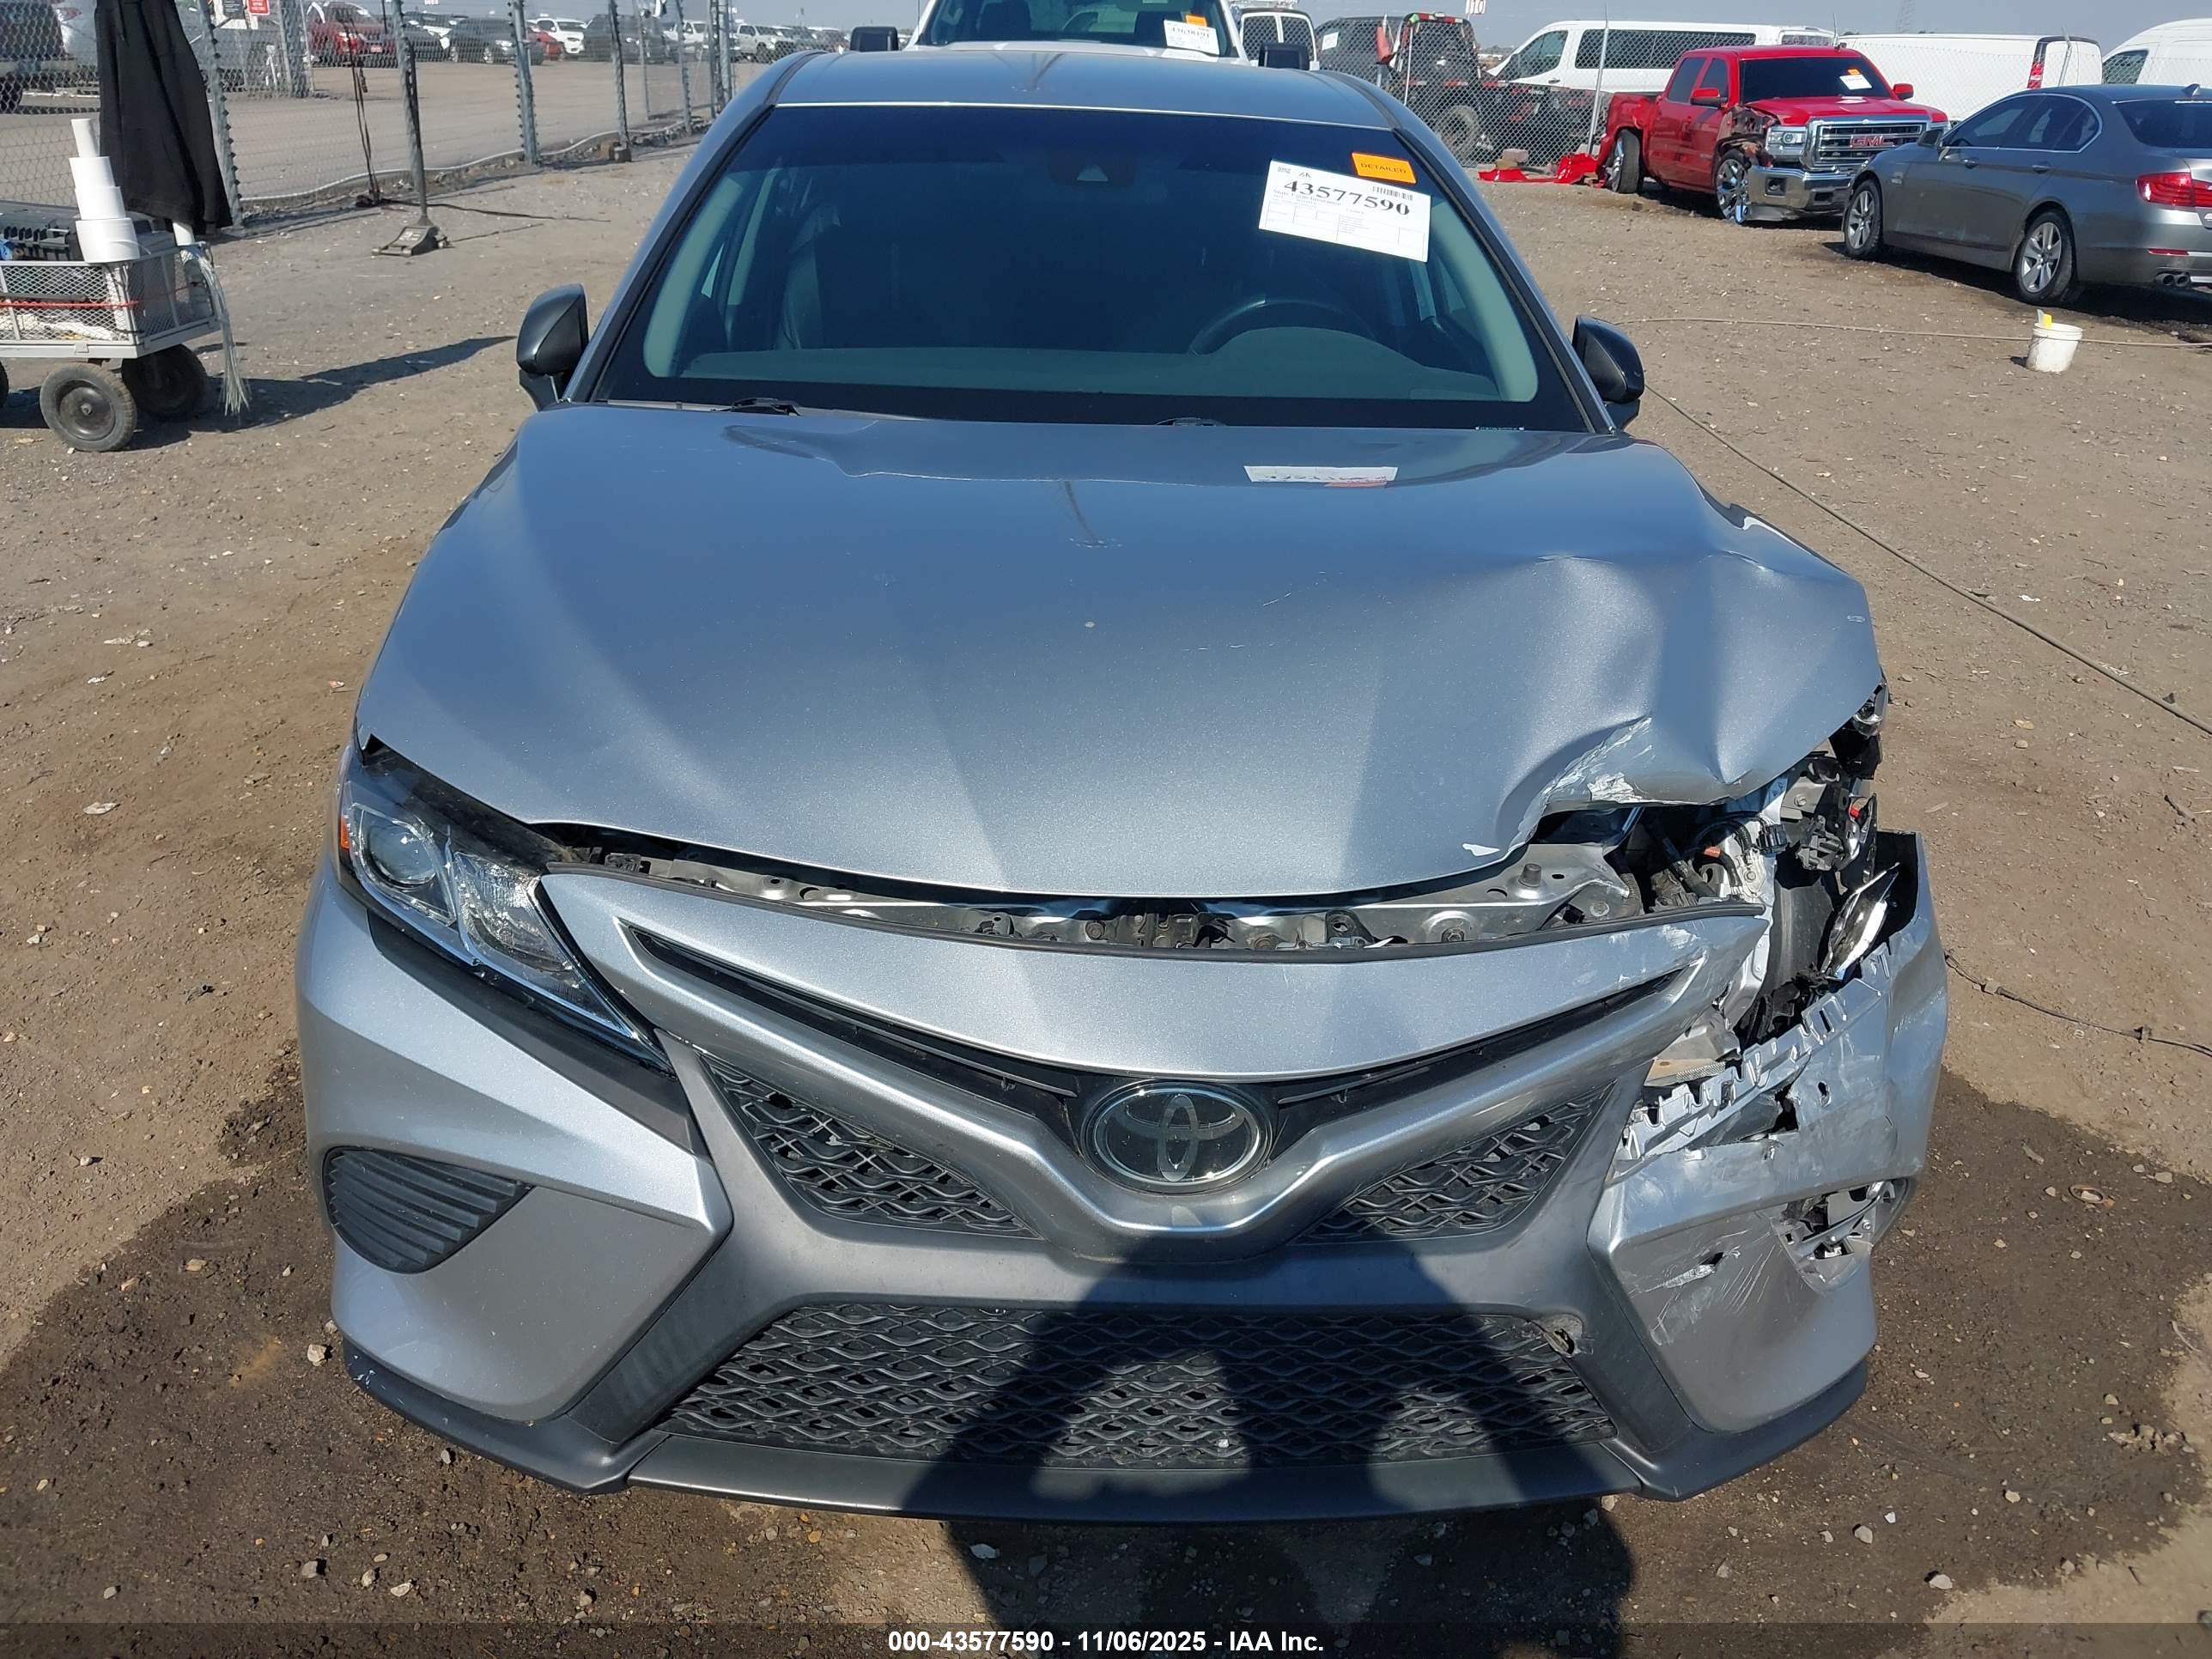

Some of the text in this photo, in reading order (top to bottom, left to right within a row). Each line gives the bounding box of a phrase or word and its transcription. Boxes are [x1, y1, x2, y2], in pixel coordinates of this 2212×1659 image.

[1850, 136, 1894, 147] GMC
[1360, 162, 1407, 174] DETAILED
[1284, 180, 1410, 216] 43577590
